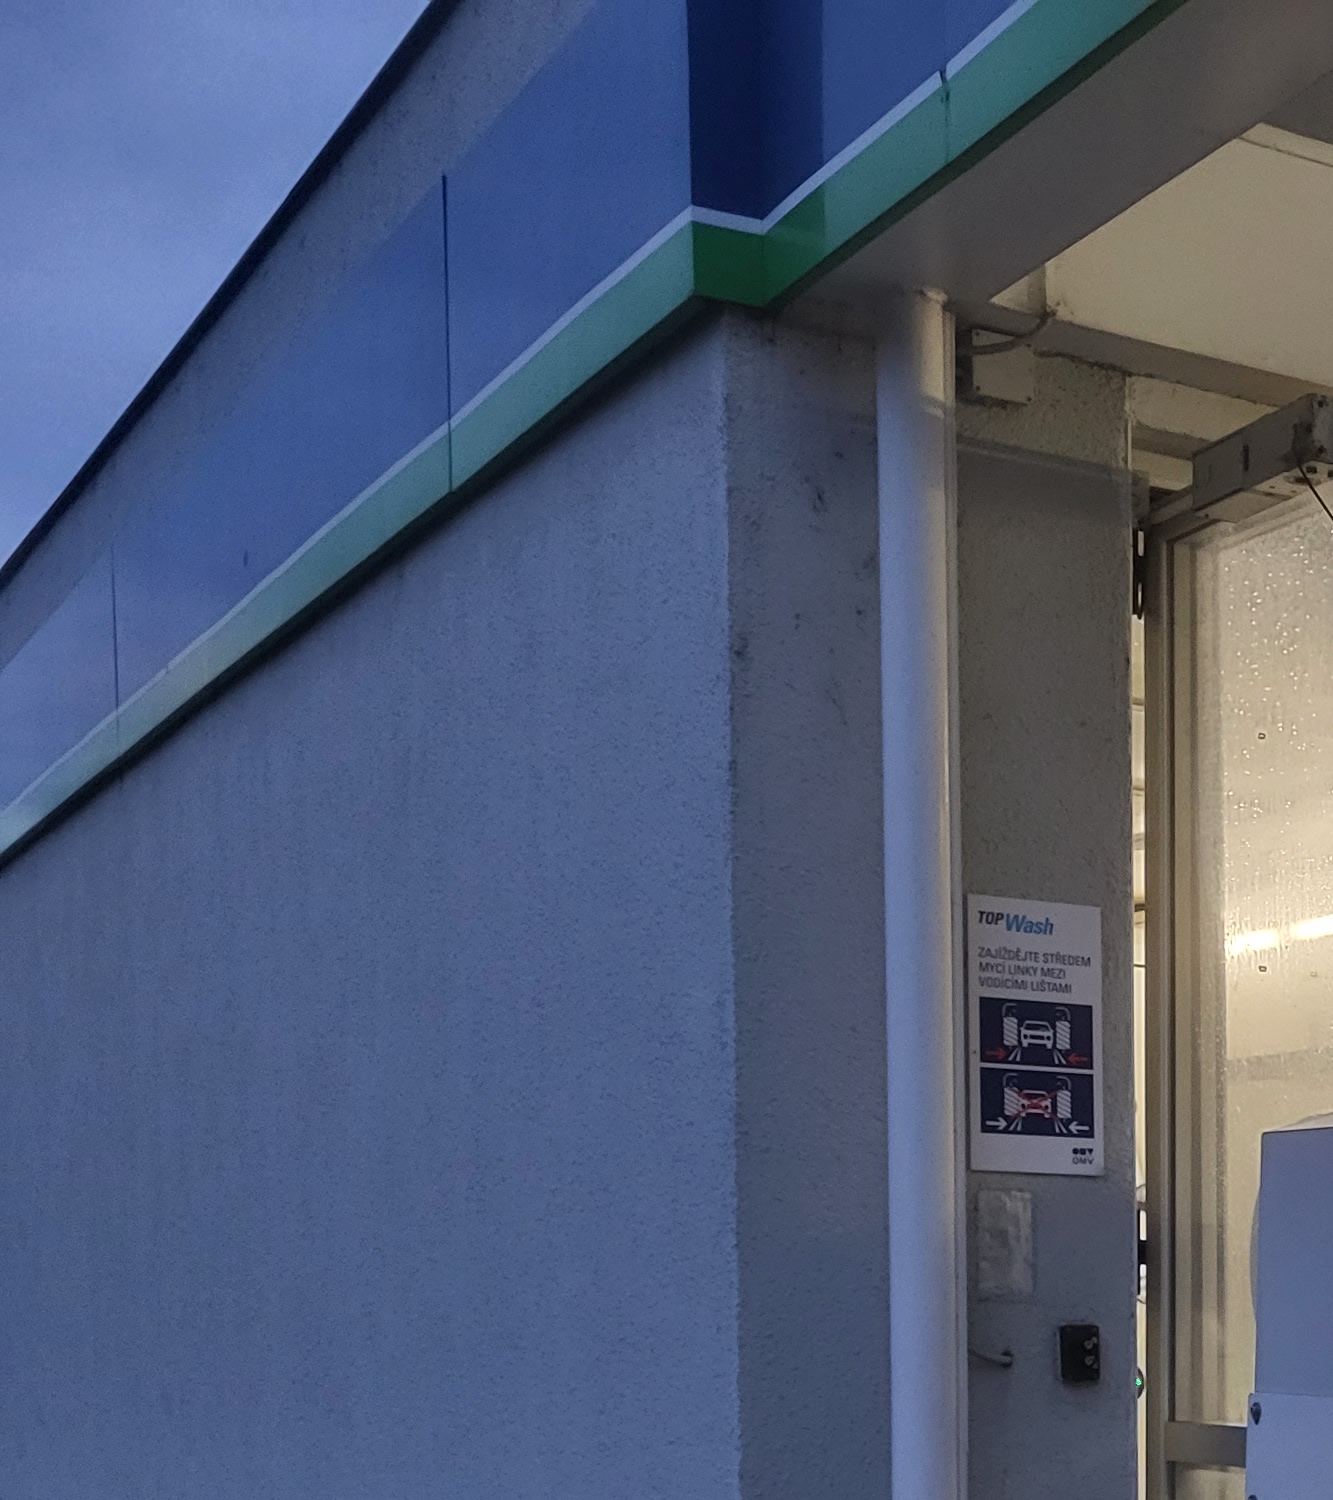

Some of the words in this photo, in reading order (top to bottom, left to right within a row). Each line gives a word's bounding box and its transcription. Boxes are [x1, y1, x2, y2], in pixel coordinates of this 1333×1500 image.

[1042, 951, 1091, 967] STŘEDEM
[1008, 964, 1038, 977] LINKY
[1040, 967, 1066, 979] MEZI
[1031, 978, 1072, 994] LIŠTAMI
